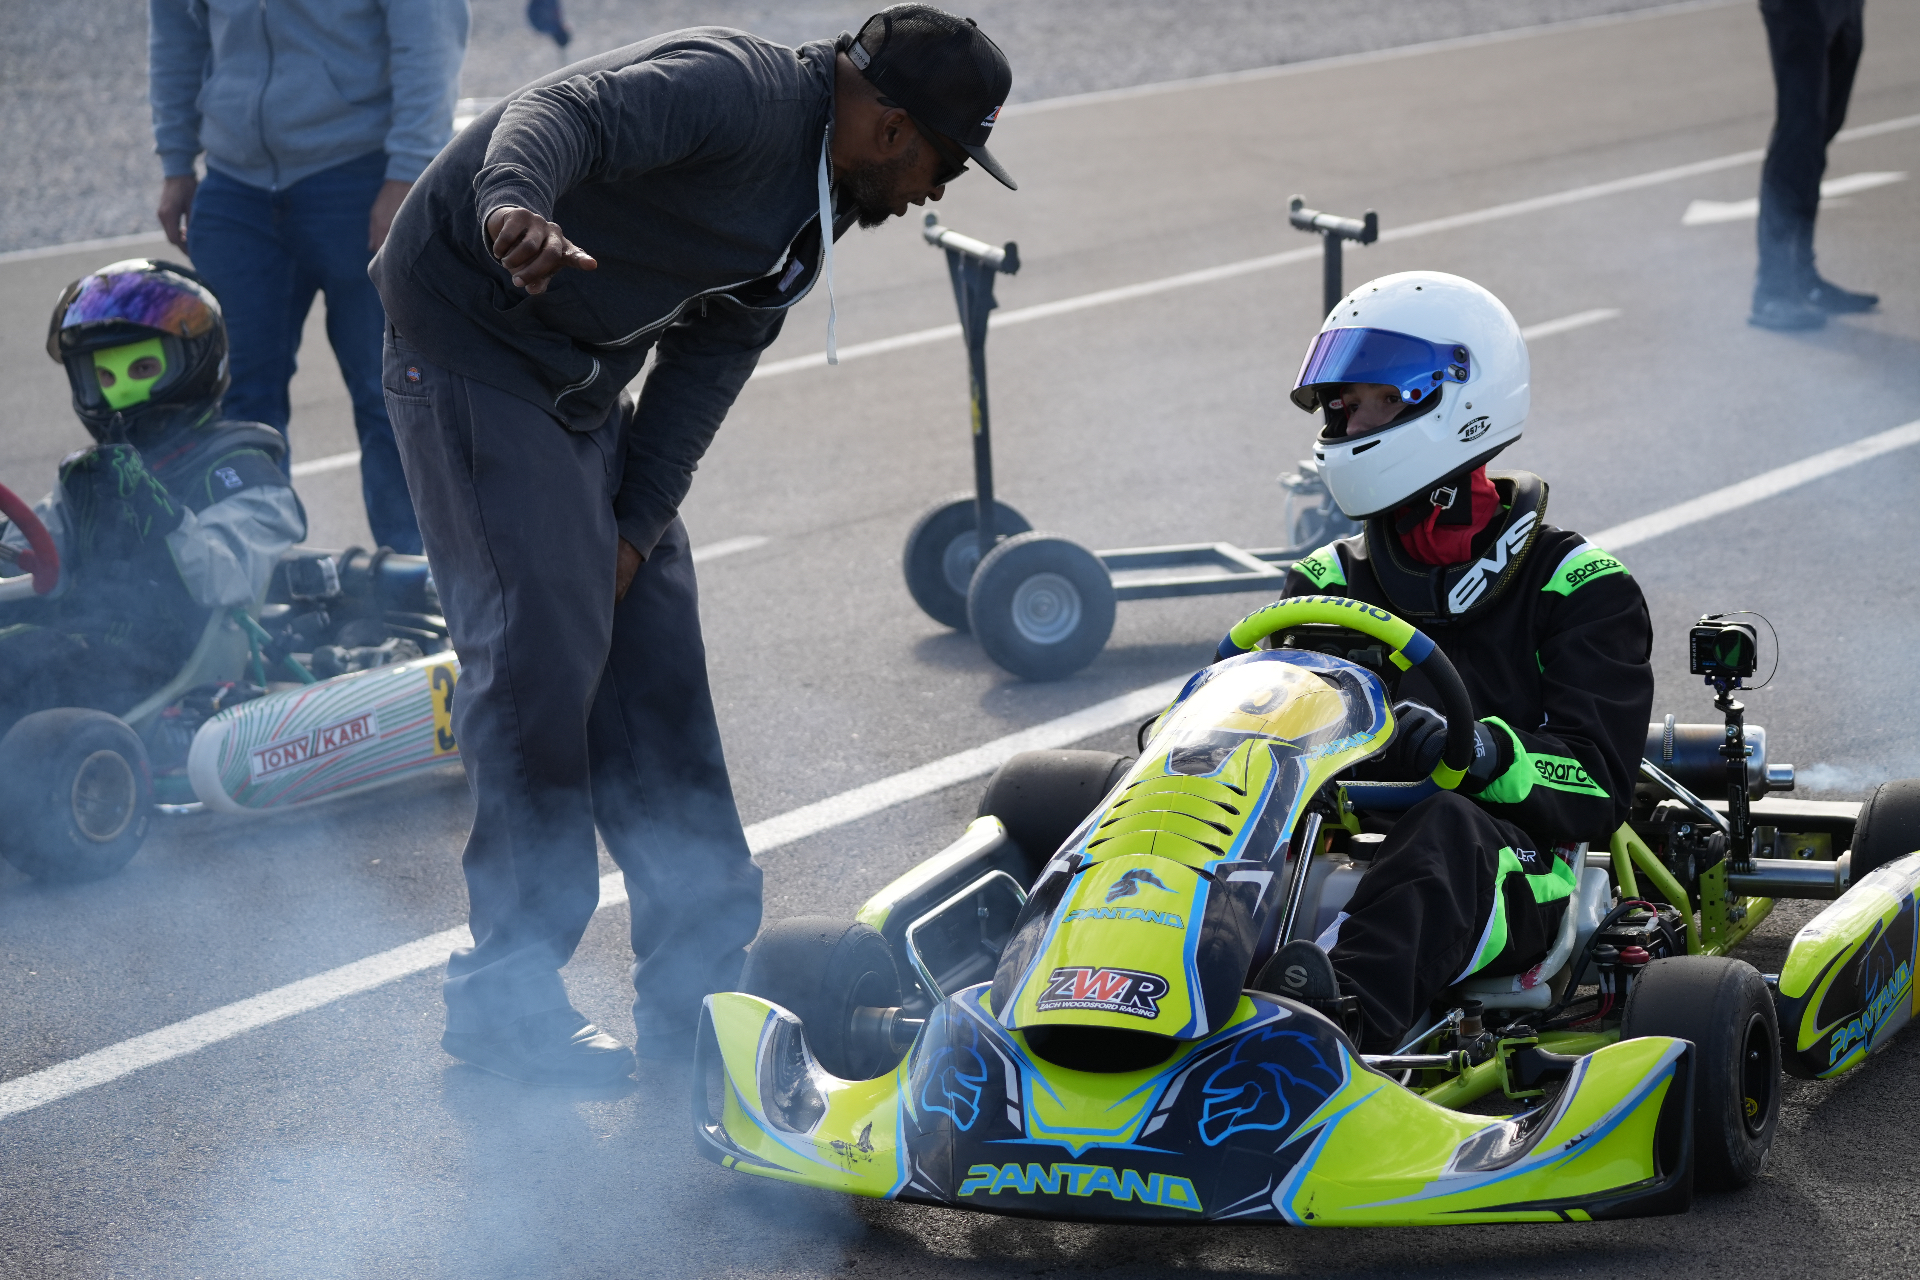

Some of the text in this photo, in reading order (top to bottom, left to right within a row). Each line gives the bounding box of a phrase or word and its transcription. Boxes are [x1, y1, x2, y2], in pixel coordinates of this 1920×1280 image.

[1448, 511, 1537, 613] EVS
[1566, 558, 1621, 586] sparco
[253, 713, 373, 771] TONY KART
[1535, 759, 1594, 783] sparc
[1038, 966, 1169, 1012] ZWR
[1039, 1000, 1156, 1018] ZACH WOODSFORD RACING
